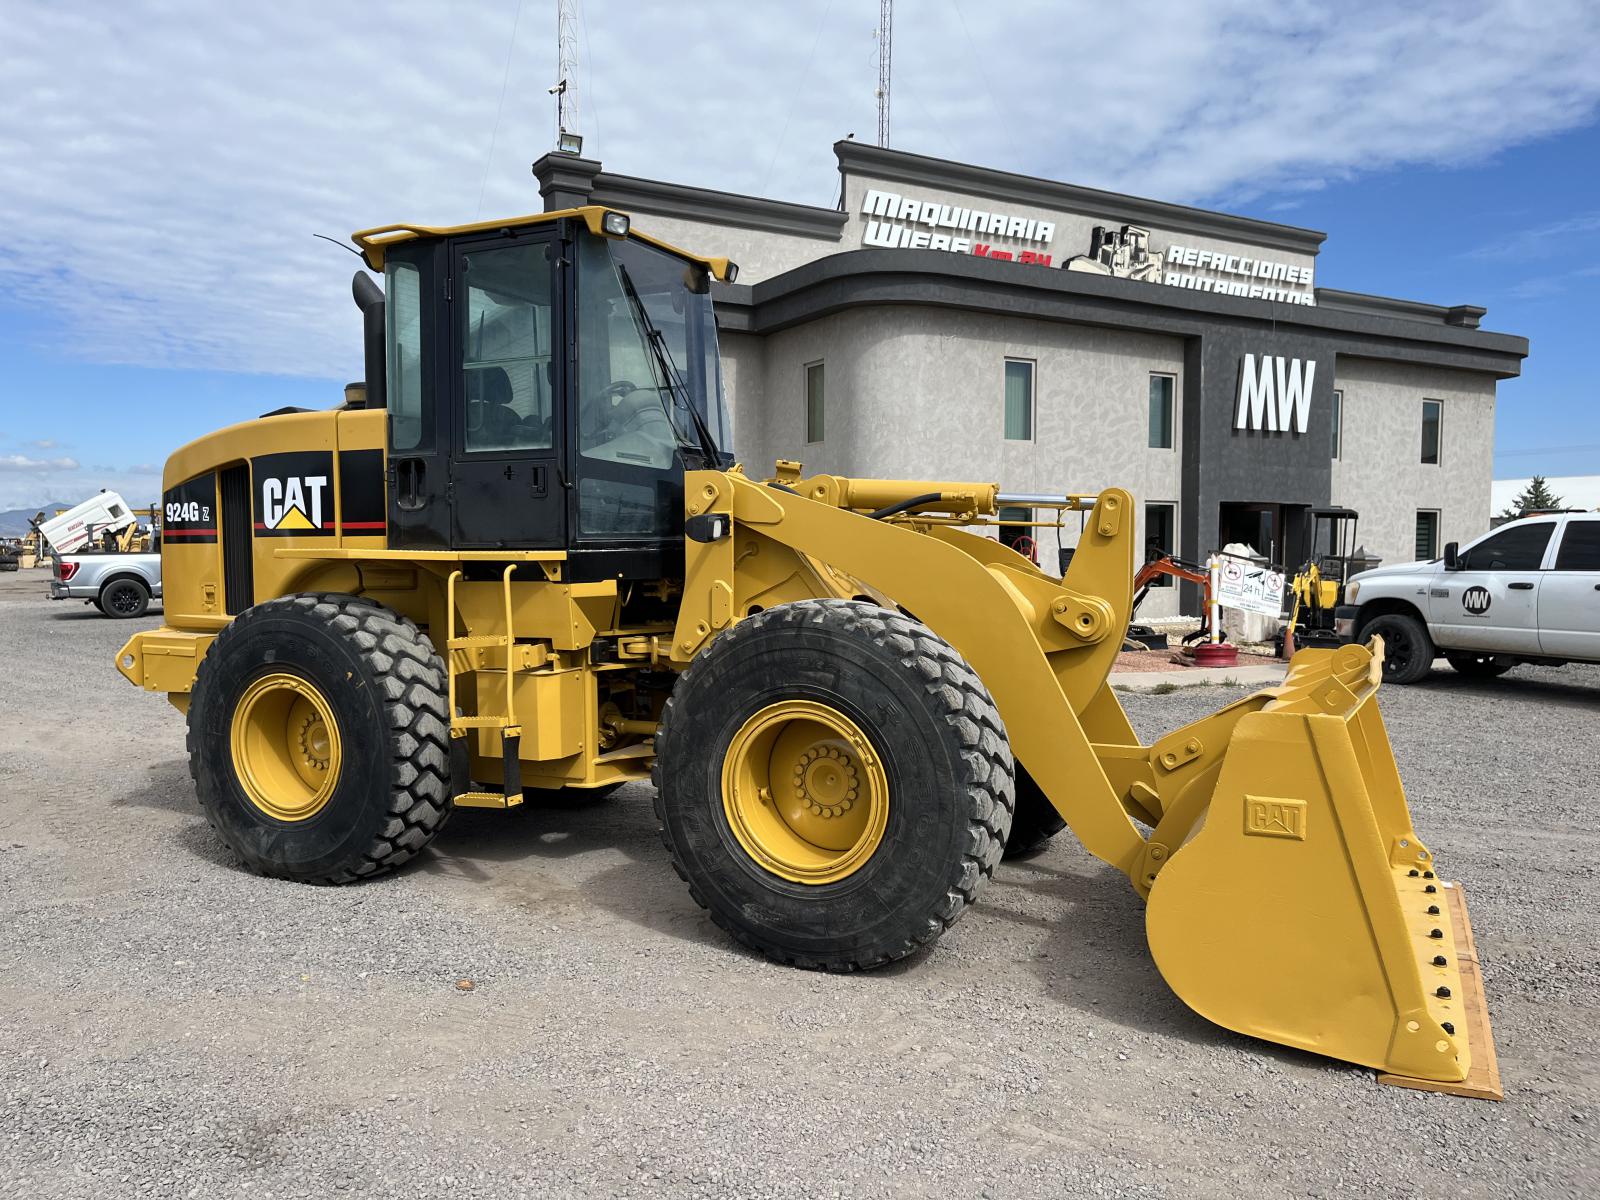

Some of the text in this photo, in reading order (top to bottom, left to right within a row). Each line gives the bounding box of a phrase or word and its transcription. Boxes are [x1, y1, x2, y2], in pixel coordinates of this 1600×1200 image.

[862, 189, 1056, 243] MAQUINARIA
[1167, 244, 1315, 285] REFACCIONES
[1237, 352, 1317, 434] MW
[166, 501, 200, 522] 924G
[262, 475, 328, 530] CAT
[1243, 583, 1253, 593] 24
[1464, 590, 1489, 609] MW
[1248, 802, 1301, 834] CAT
